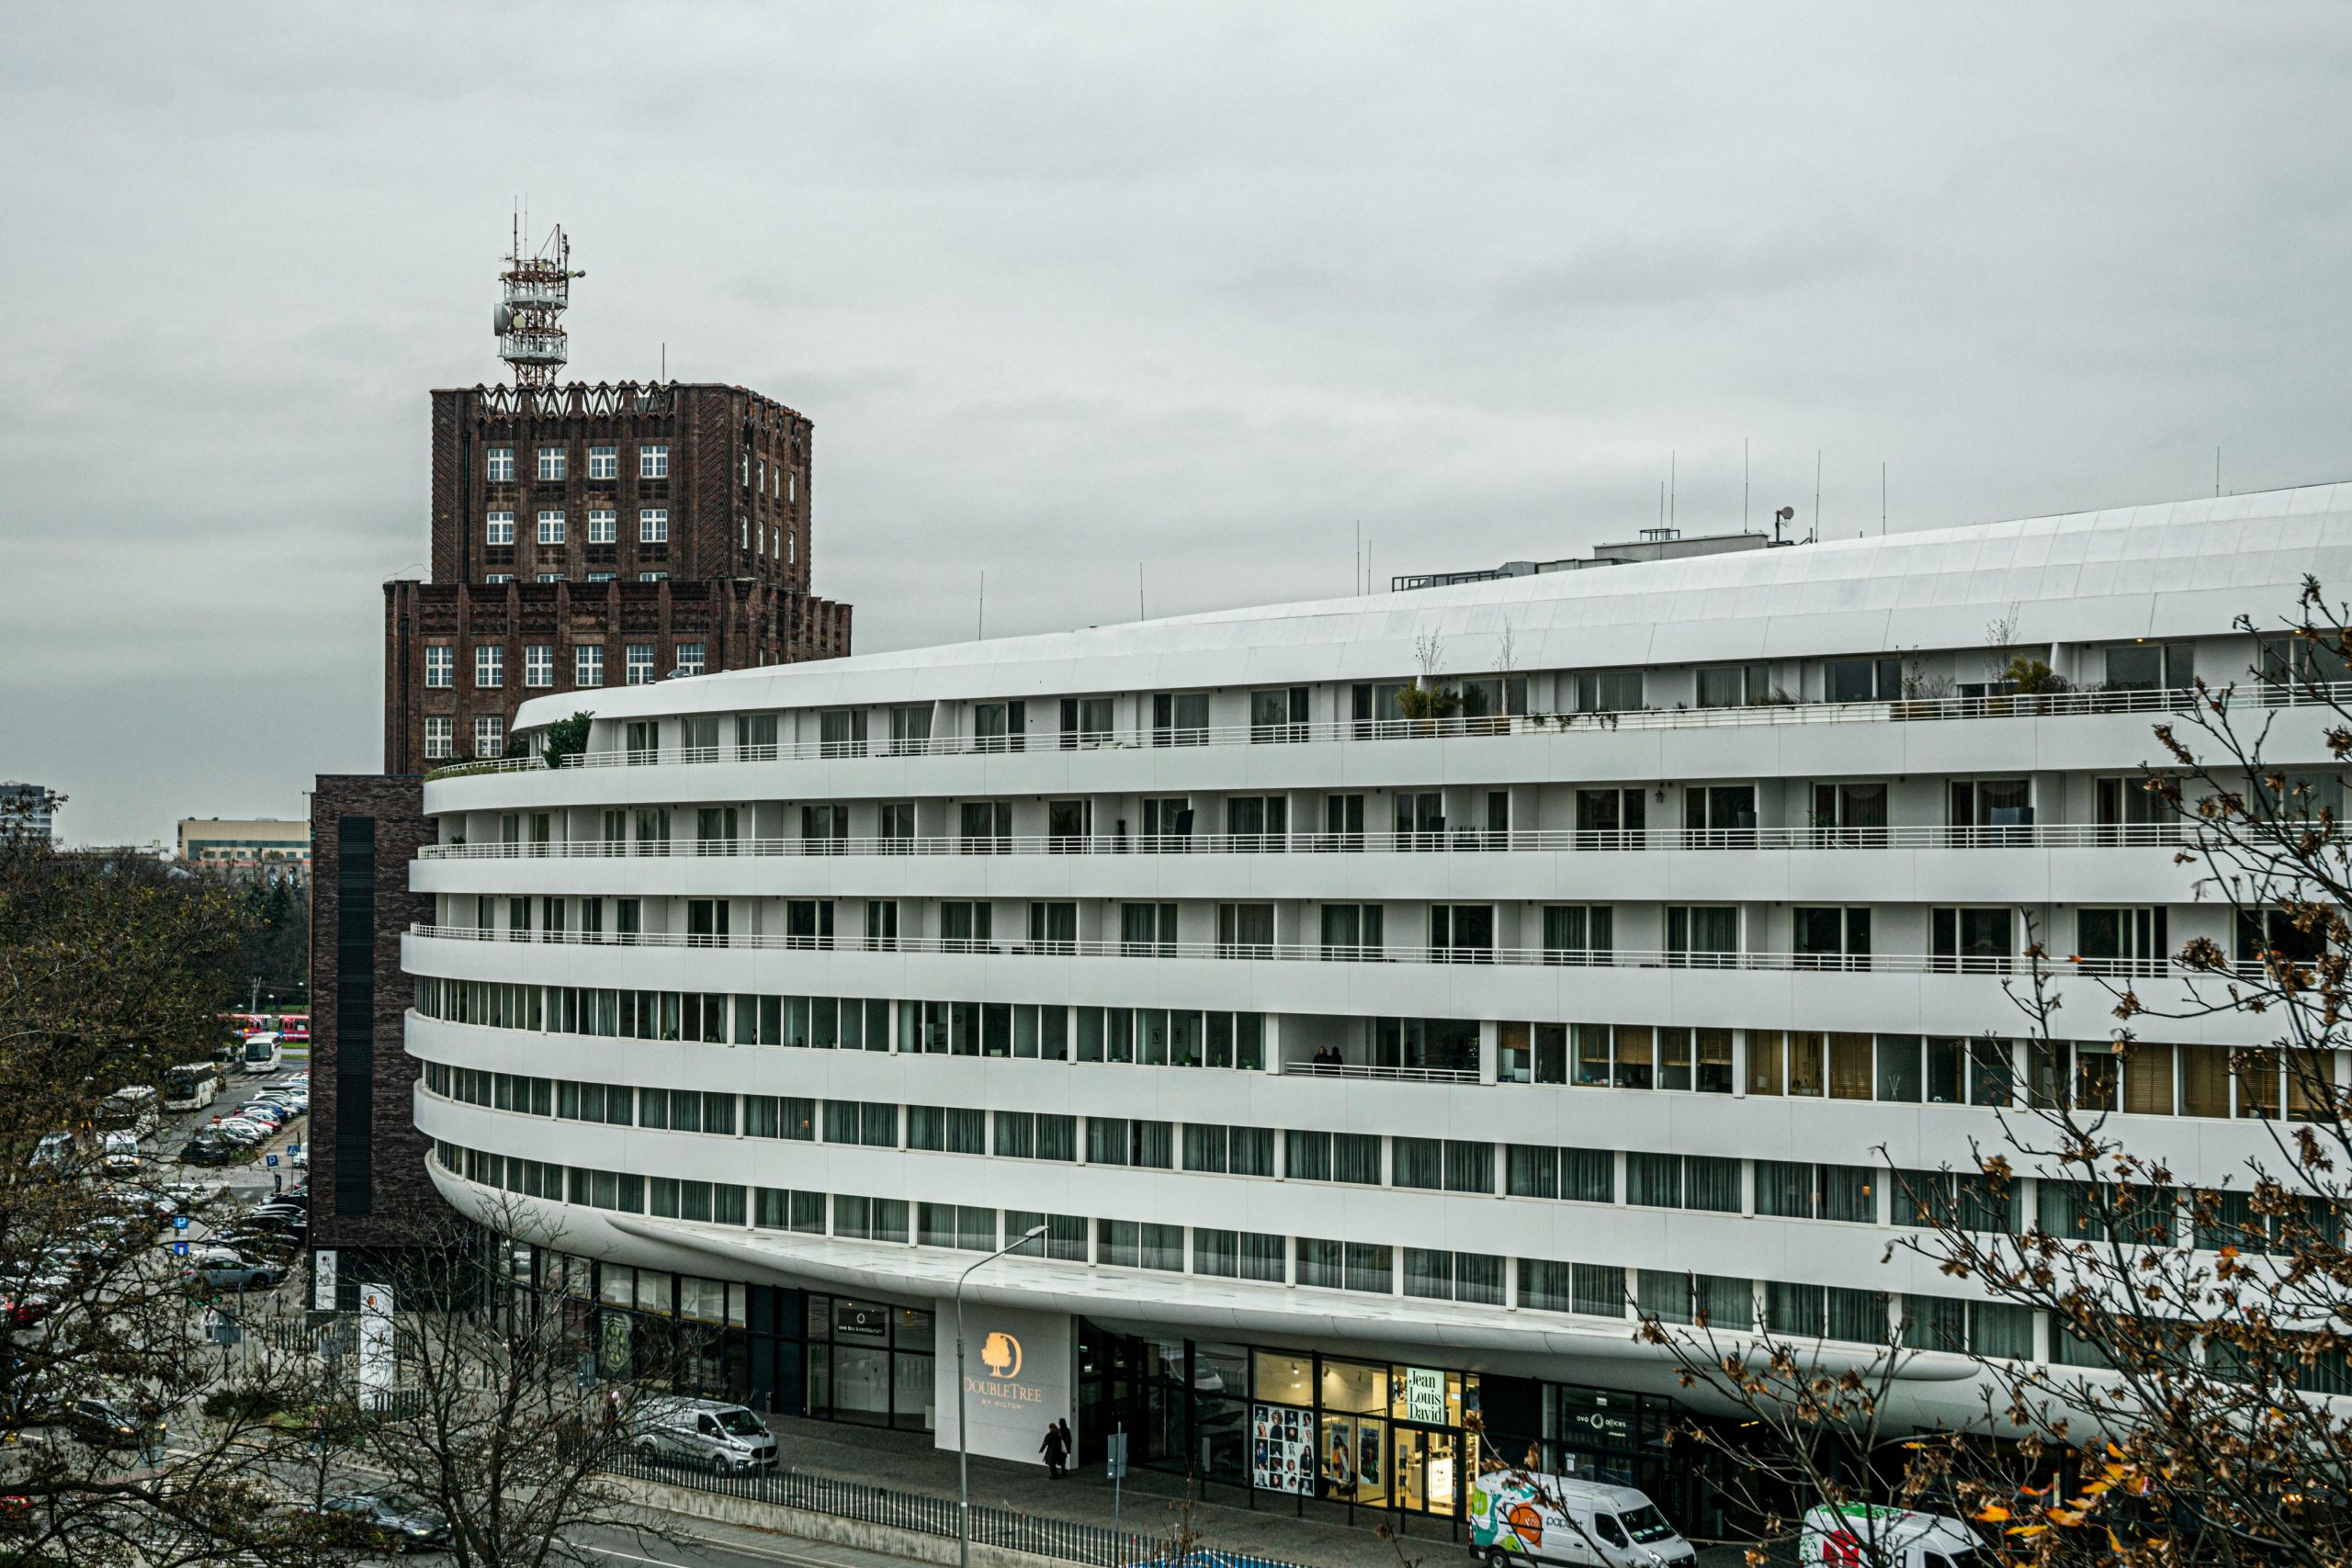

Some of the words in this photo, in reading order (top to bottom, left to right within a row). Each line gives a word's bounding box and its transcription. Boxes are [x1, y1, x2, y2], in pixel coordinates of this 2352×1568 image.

[268, 1156, 277, 1166] P
[177, 1218, 186, 1227] P
[1408, 1370, 1436, 1389] Jean
[1409, 1386, 1442, 1406] Louis
[994, 1400, 1022, 1410] HILTON
[1409, 1403, 1442, 1423] David
[1605, 1419, 1626, 1427] offices
